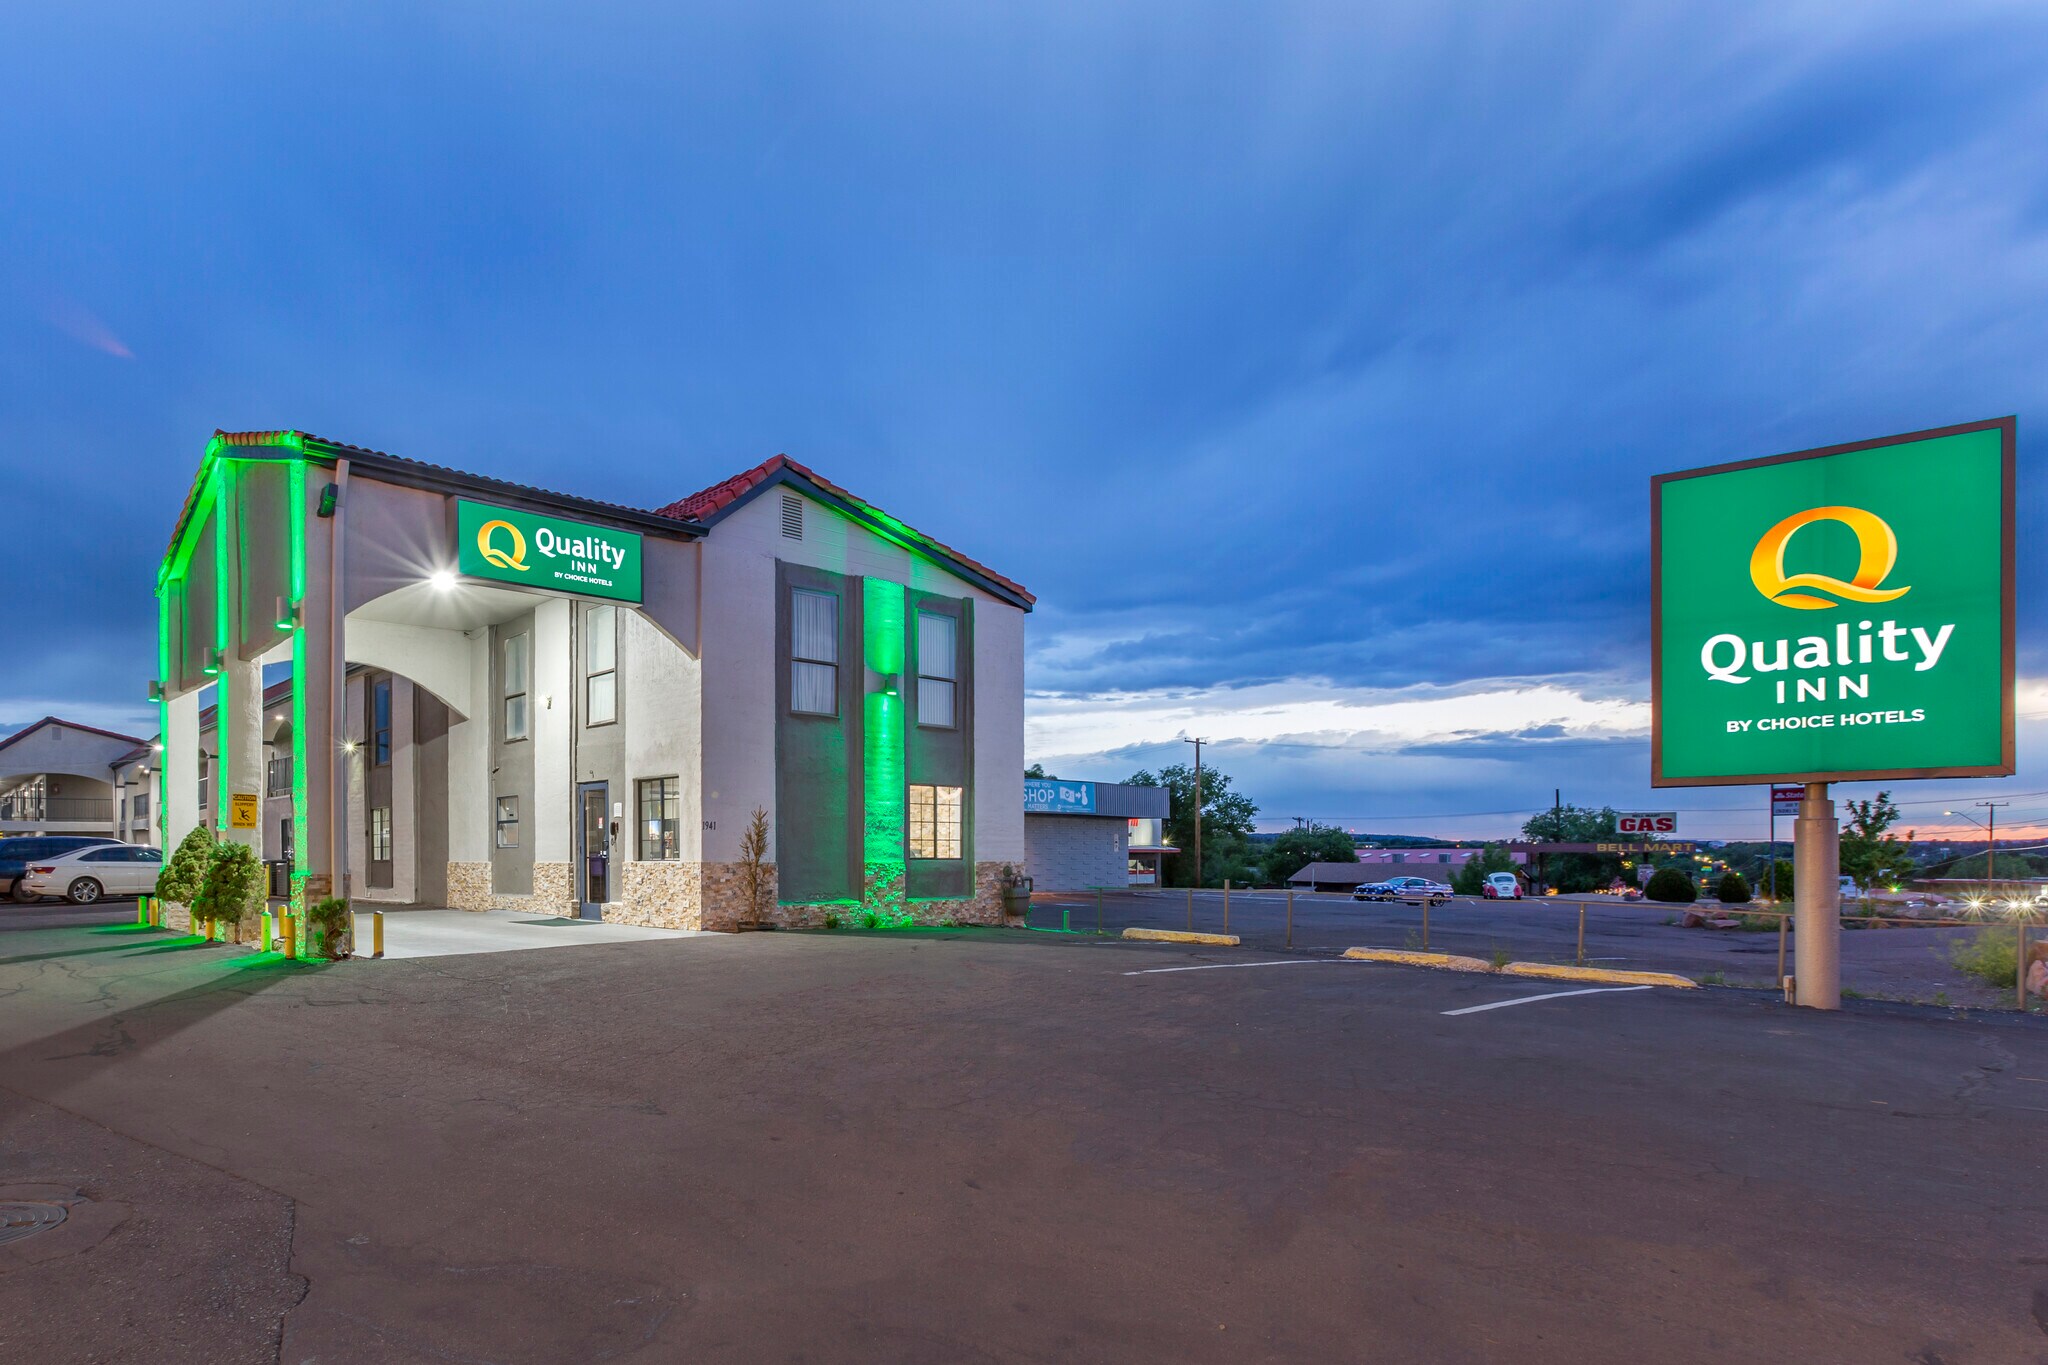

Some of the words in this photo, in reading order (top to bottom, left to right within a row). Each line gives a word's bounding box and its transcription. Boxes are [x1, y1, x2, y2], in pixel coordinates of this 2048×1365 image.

[535, 528, 626, 570] Quality
[572, 560, 597, 574] INN
[564, 572, 588, 583] CHOICE
[589, 577, 613, 587] HOTELS
[1700, 620, 1956, 684] Quality
[1776, 674, 1869, 704] INN
[1726, 719, 1752, 733] BY
[1757, 714, 1834, 731] CHOICE
[1840, 708, 1925, 726] HOTELS
[702, 821, 716, 830] 1941
[1620, 818, 1673, 832] GAS
[1597, 843, 1638, 852] BELL
[1644, 843, 1694, 852] MART
